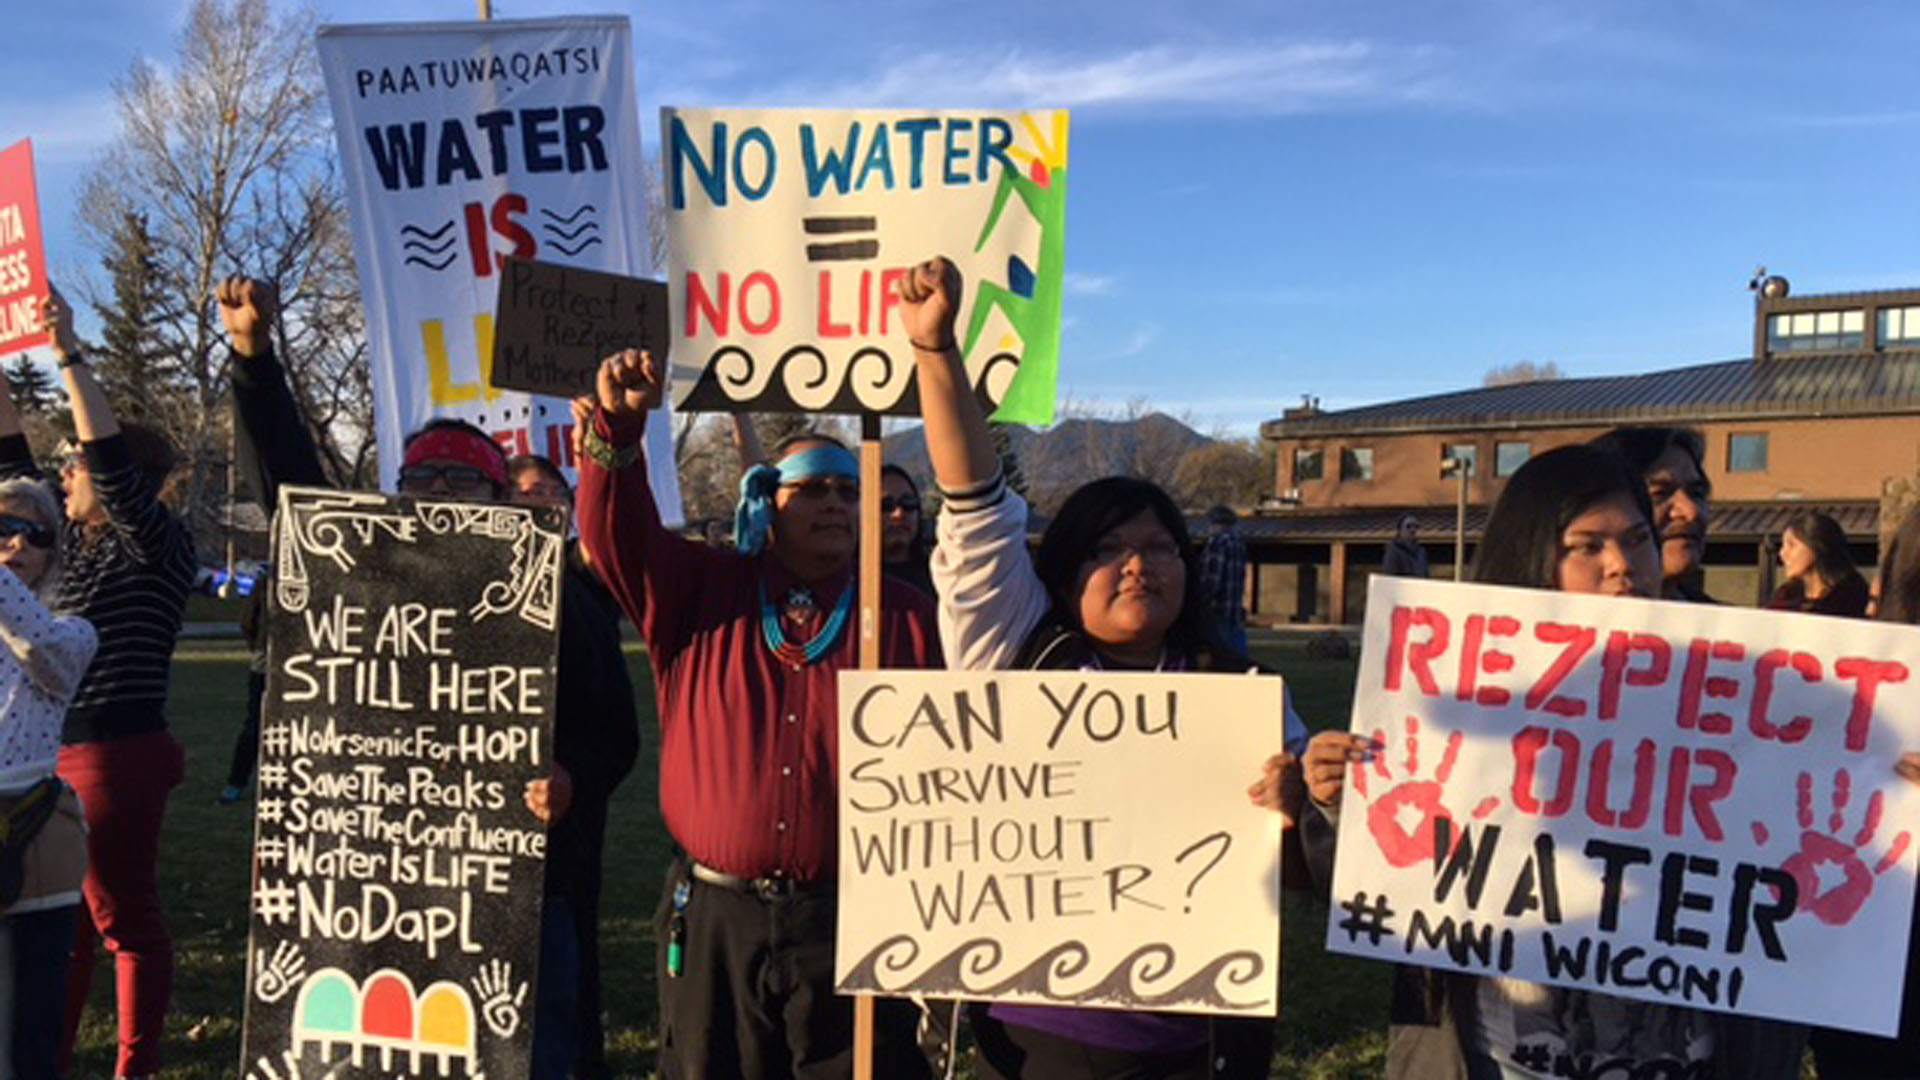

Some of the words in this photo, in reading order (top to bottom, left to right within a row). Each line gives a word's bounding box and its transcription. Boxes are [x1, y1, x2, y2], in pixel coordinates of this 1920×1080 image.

[365, 104, 608, 190] WATER
[671, 115, 776, 210] NO
[800, 117, 1018, 198] WATER
[464, 193, 537, 277] IS
[511, 262, 619, 322] Protect
[686, 270, 781, 338] NO
[818, 267, 908, 337] LIF
[305, 594, 365, 652] WE
[375, 603, 457, 657] ARE
[282, 654, 414, 709] STILL
[430, 661, 544, 714] HERE
[1384, 605, 1909, 753] REZPECT
[263, 716, 540, 765] #NoArsenicForHOPI
[851, 680, 1003, 752] CAN
[1039, 681, 1179, 750] YOU
[260, 758, 505, 810] #SaveThePeaks
[850, 758, 1082, 813] SURVIVE
[1510, 724, 1738, 842] OUR
[258, 797, 546, 859] #SaveTheConfluence
[851, 815, 1111, 877] WITHOUT
[1432, 815, 1800, 962] WATER
[1541, 931, 1743, 1008] WICONI
